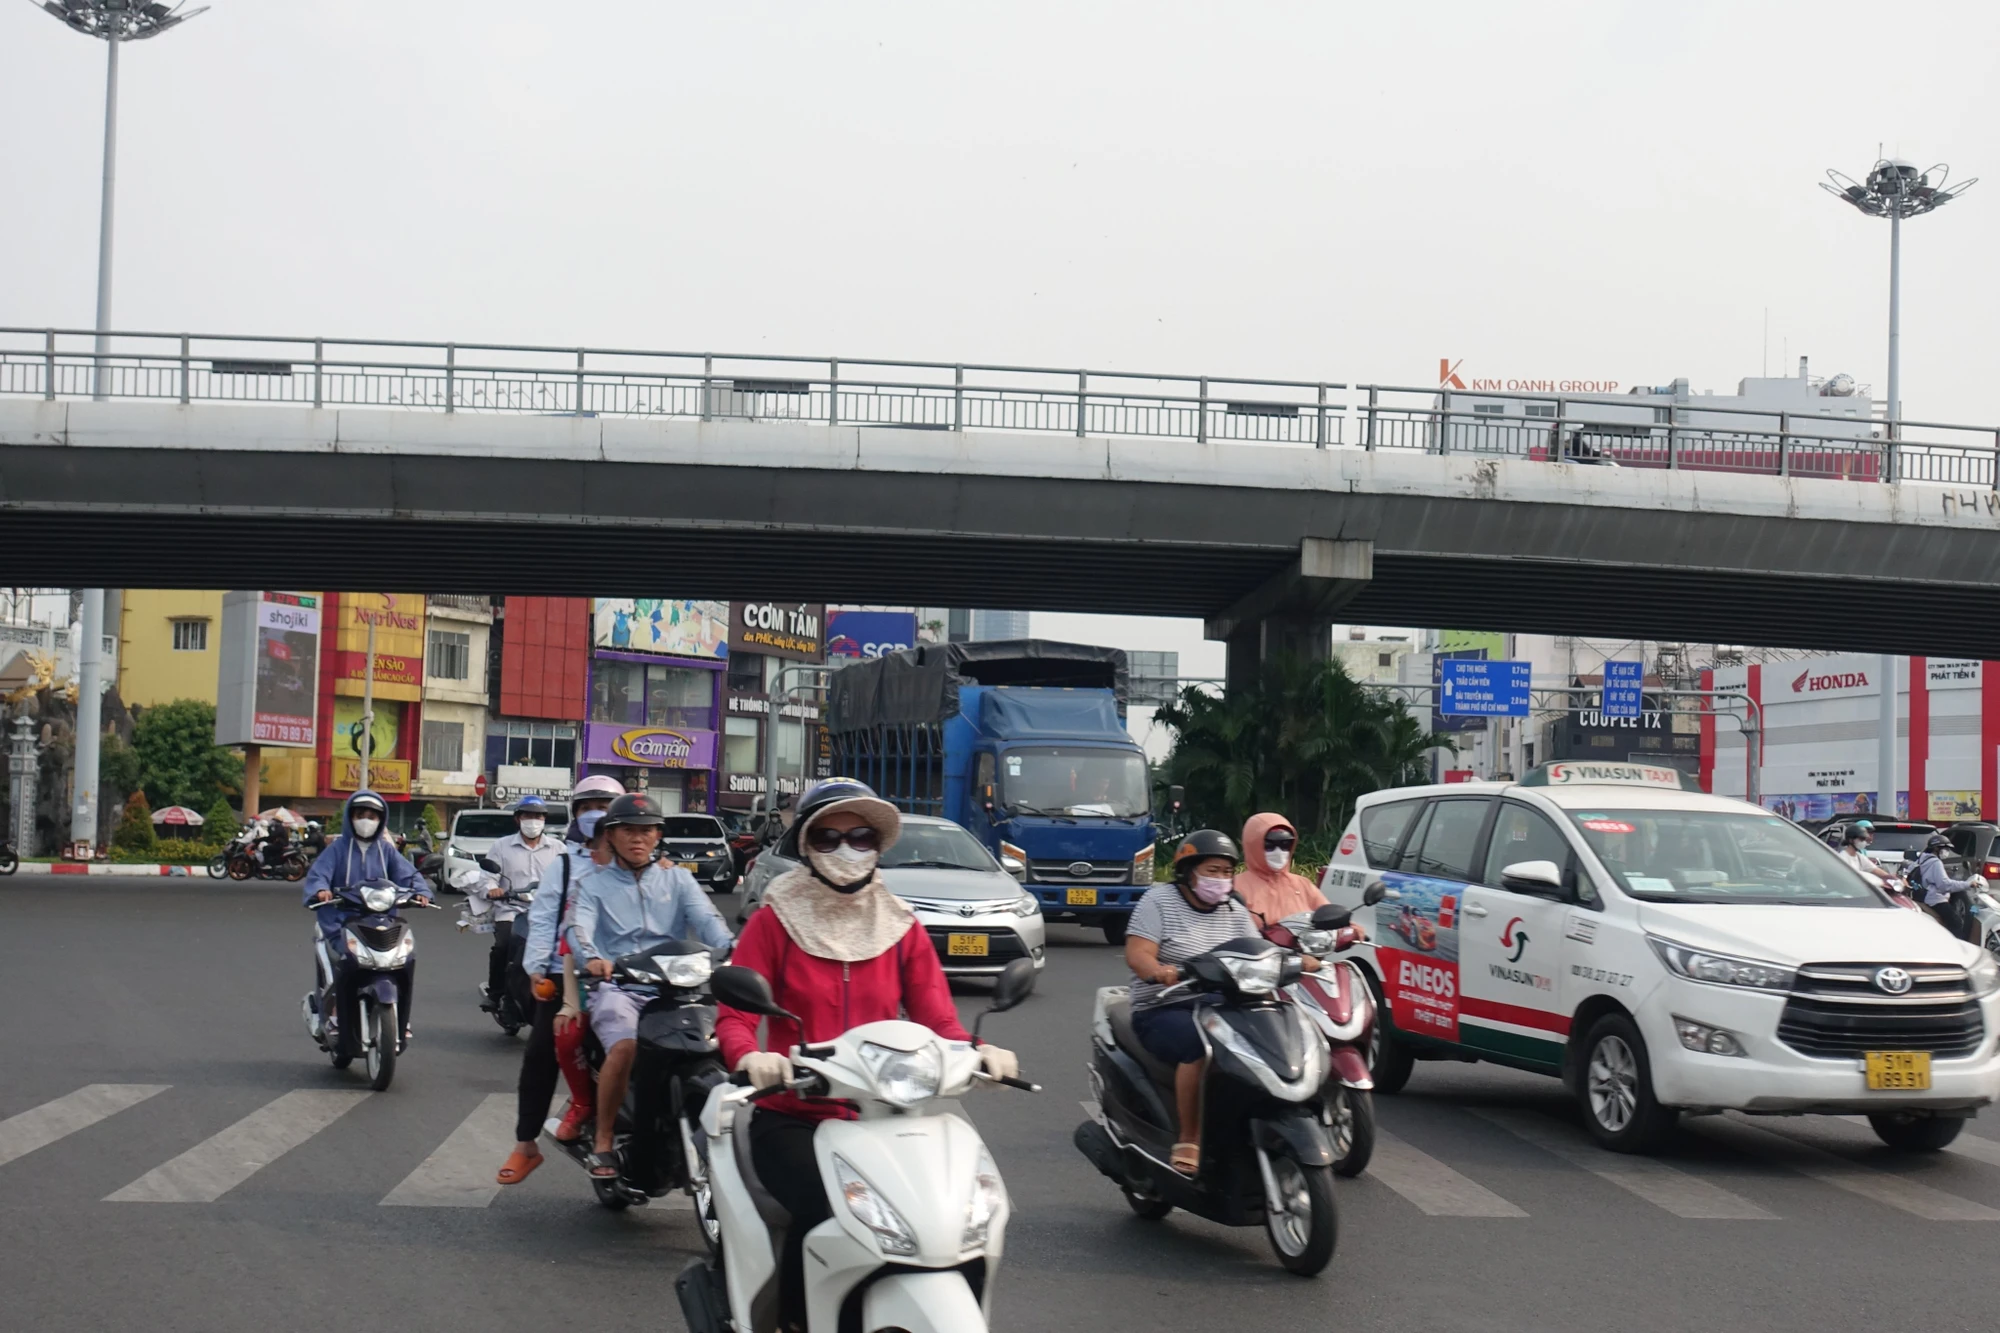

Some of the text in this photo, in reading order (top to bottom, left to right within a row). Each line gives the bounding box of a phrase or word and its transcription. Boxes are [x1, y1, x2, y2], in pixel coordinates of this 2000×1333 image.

[1472, 378, 1618, 393] KIM OANH GROUP
[269, 610, 308, 628] shojiki
[744, 602, 818, 639] CƠM TẤM
[1456, 676, 1468, 685] THẢO
[1480, 678, 1490, 686] VIÊN
[1809, 672, 1869, 691] HONDA
[1931, 671, 1951, 680] PHÁT
[1970, 671, 1976, 679] 6
[728, 696, 739, 713] HỆ
[739, 696, 763, 713] THỐNG
[1482, 692, 1494, 700] HÌNH
[1455, 702, 1471, 711] THÀNH
[1471, 702, 1480, 711] PHỐ
[1642, 712, 1661, 729] TX
[278, 725, 288, 740] 79
[302, 727, 312, 742] 79
[662, 738, 690, 757] TẤM
[1577, 767, 1674, 783] VINASUN TAXI
[729, 775, 757, 792] Sườn
[780, 778, 795, 794] Than
[959, 936, 977, 944] 51F
[1398, 959, 1455, 998] ENEOS
[1489, 964, 1534, 986] VINASUN
[1885, 1055, 1914, 1069] 51H
[1876, 1072, 1925, 1088] 189.91
